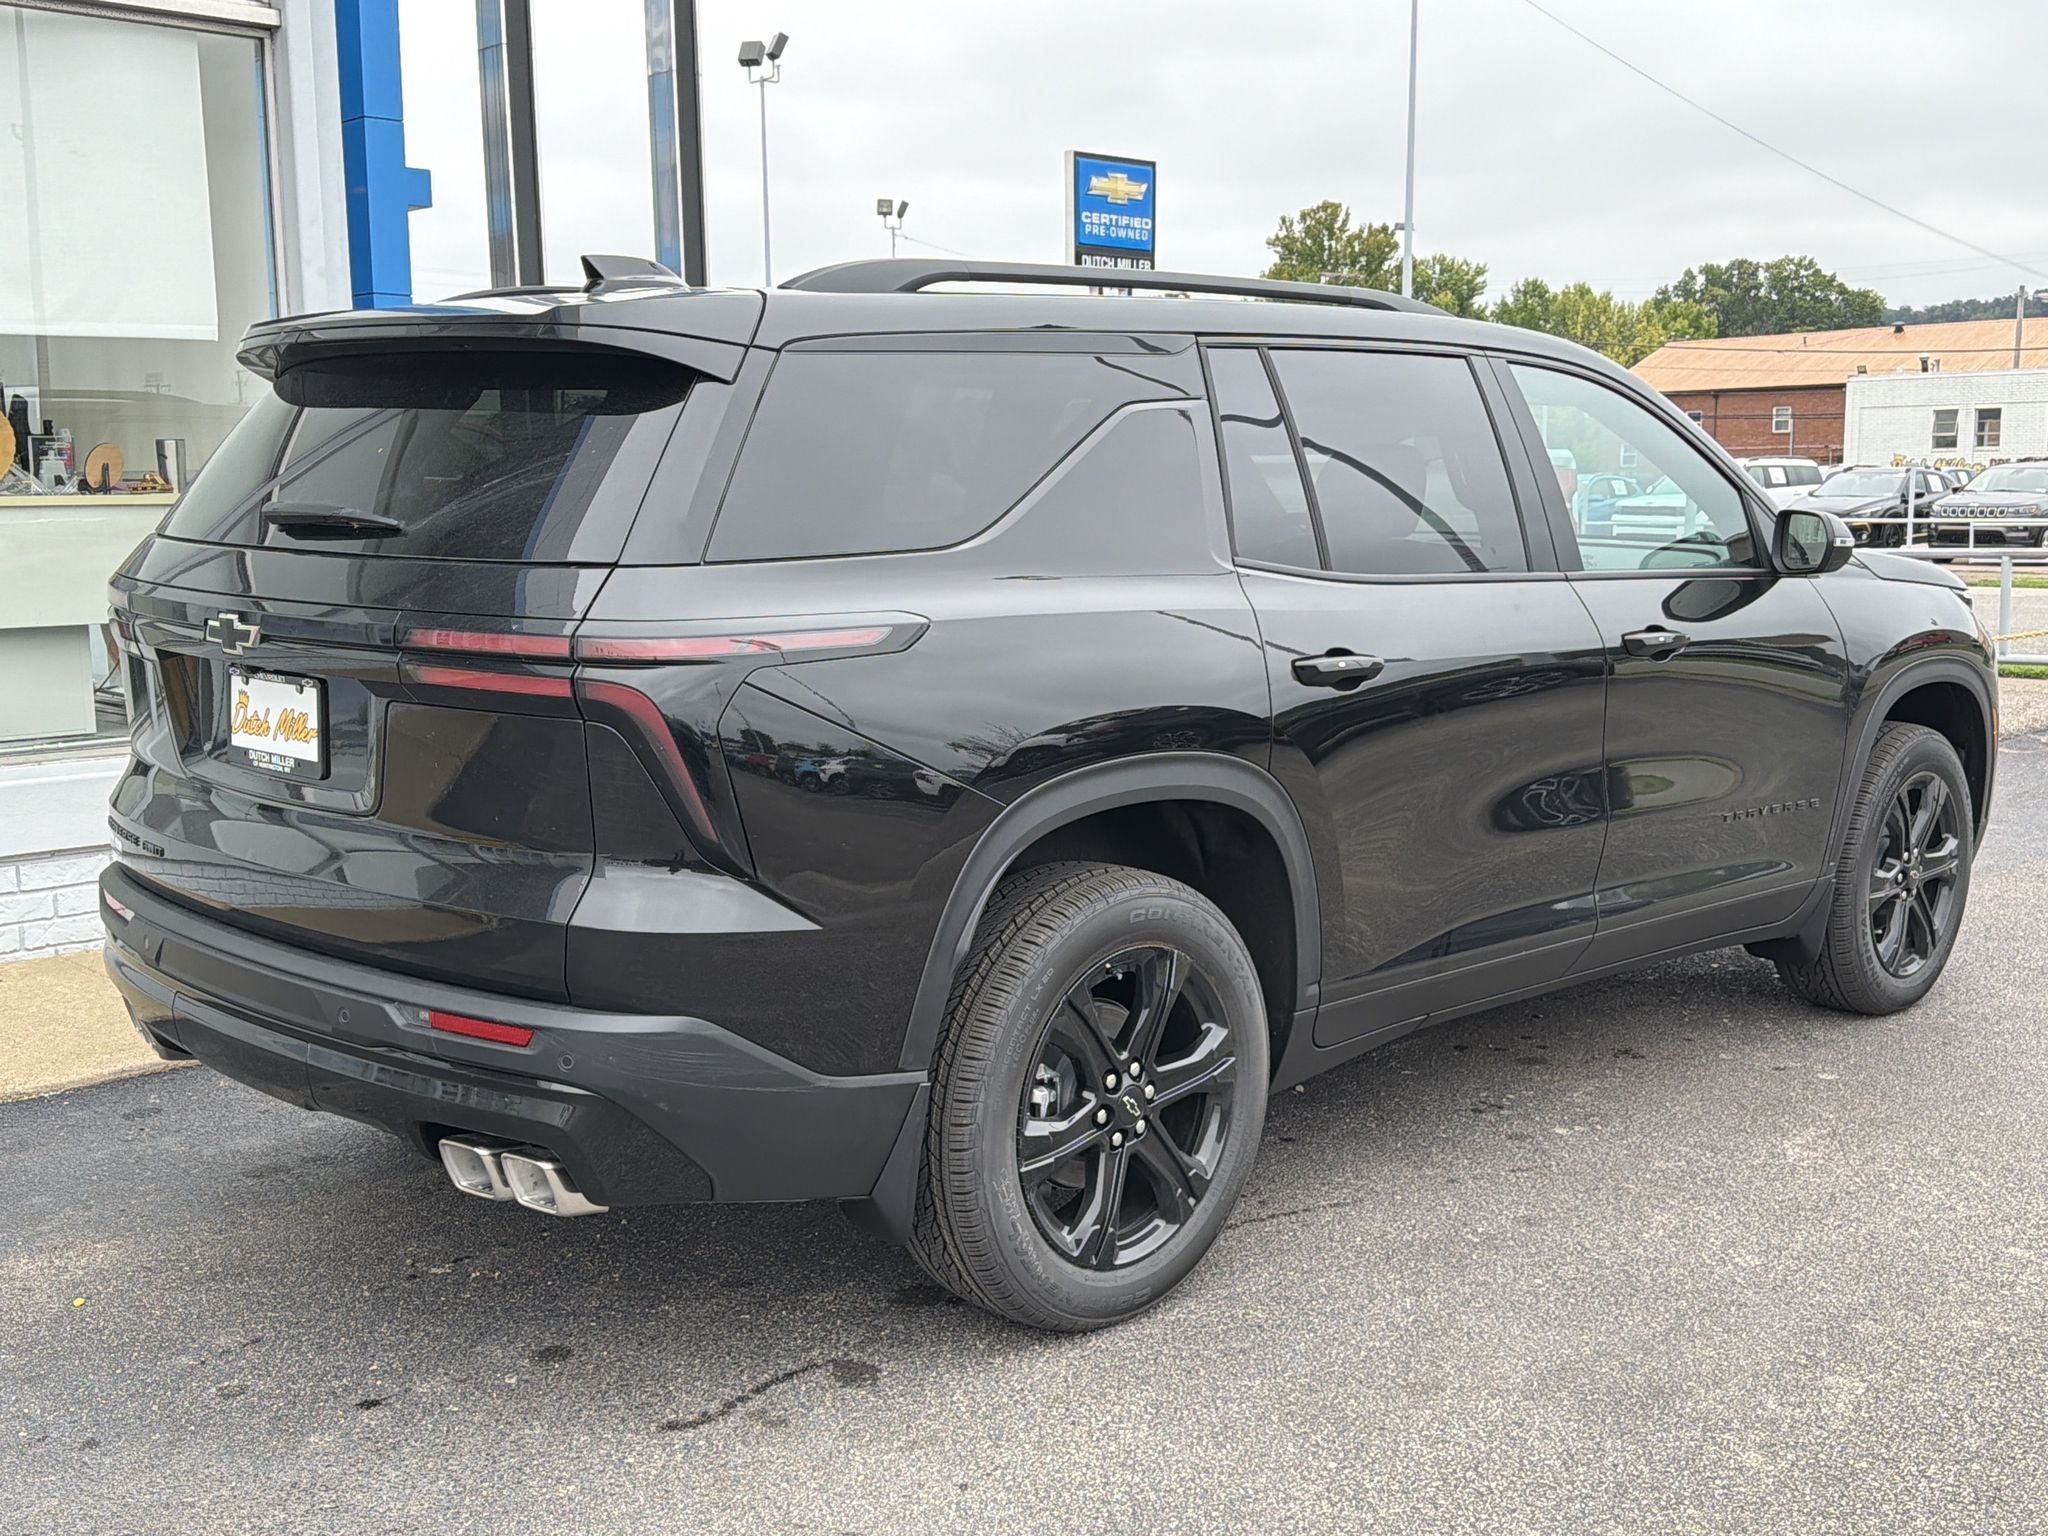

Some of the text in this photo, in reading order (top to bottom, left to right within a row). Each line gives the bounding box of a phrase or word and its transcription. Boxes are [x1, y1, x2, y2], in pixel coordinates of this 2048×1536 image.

[1081, 211, 1152, 229] CERTIFIED
[1085, 224, 1148, 240] PRE-OWNED
[1081, 254, 1115, 269] DUTCH
[231, 702, 318, 742] Dutch Miller
[248, 750, 295, 768] DUTCH MILLER
[1721, 798, 1820, 823] TRAVERSE
